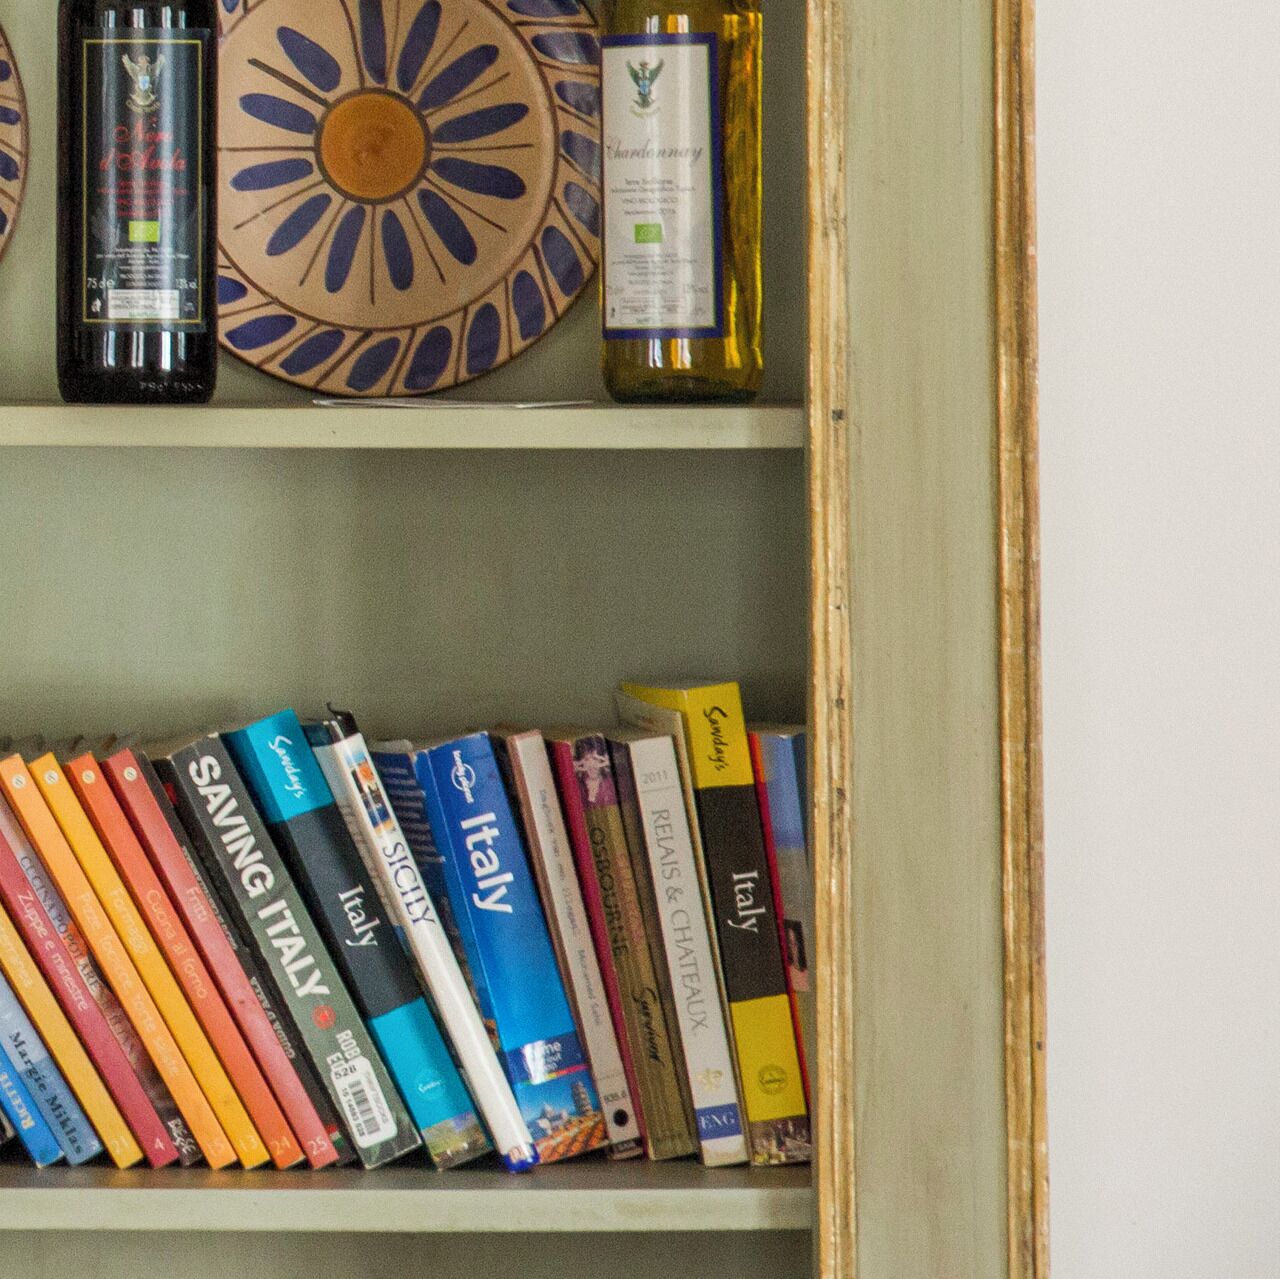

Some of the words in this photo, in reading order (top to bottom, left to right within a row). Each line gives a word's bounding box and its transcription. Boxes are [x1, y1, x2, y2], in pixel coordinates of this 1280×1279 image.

[606, 136, 704, 166] Chardonnay
[268, 734, 307, 799] Sawday's
[702, 704, 729, 773] Sawday's
[641, 769, 669, 786] 2011
[461, 812, 514, 915] Italy
[649, 806, 681, 881] RELAIS
[18, 853, 59, 915] CUCINA
[185, 884, 211, 924] Fritti
[189, 755, 275, 899] SAVING
[258, 899, 331, 998] ITALY
[383, 841, 439, 928] SICILY
[587, 825, 629, 959] OSBOURNE
[664, 883, 685, 904] &
[727, 872, 760, 934] Italy
[143, 886, 178, 941] Cucina
[170, 939, 188, 957] al
[180, 955, 211, 1001] forno
[338, 884, 382, 949] Italy
[16, 888, 50, 941] Zuppe
[42, 938, 56, 952] e
[51, 951, 90, 1013] minestre
[668, 907, 710, 1033] CHATEAUX
[6, 1030, 49, 1095] Margie
[44, 1093, 87, 1156] Miklas
[700, 1110, 735, 1132] ENG
[152, 1136, 166, 1152] 4
[306, 1135, 328, 1156] 25
